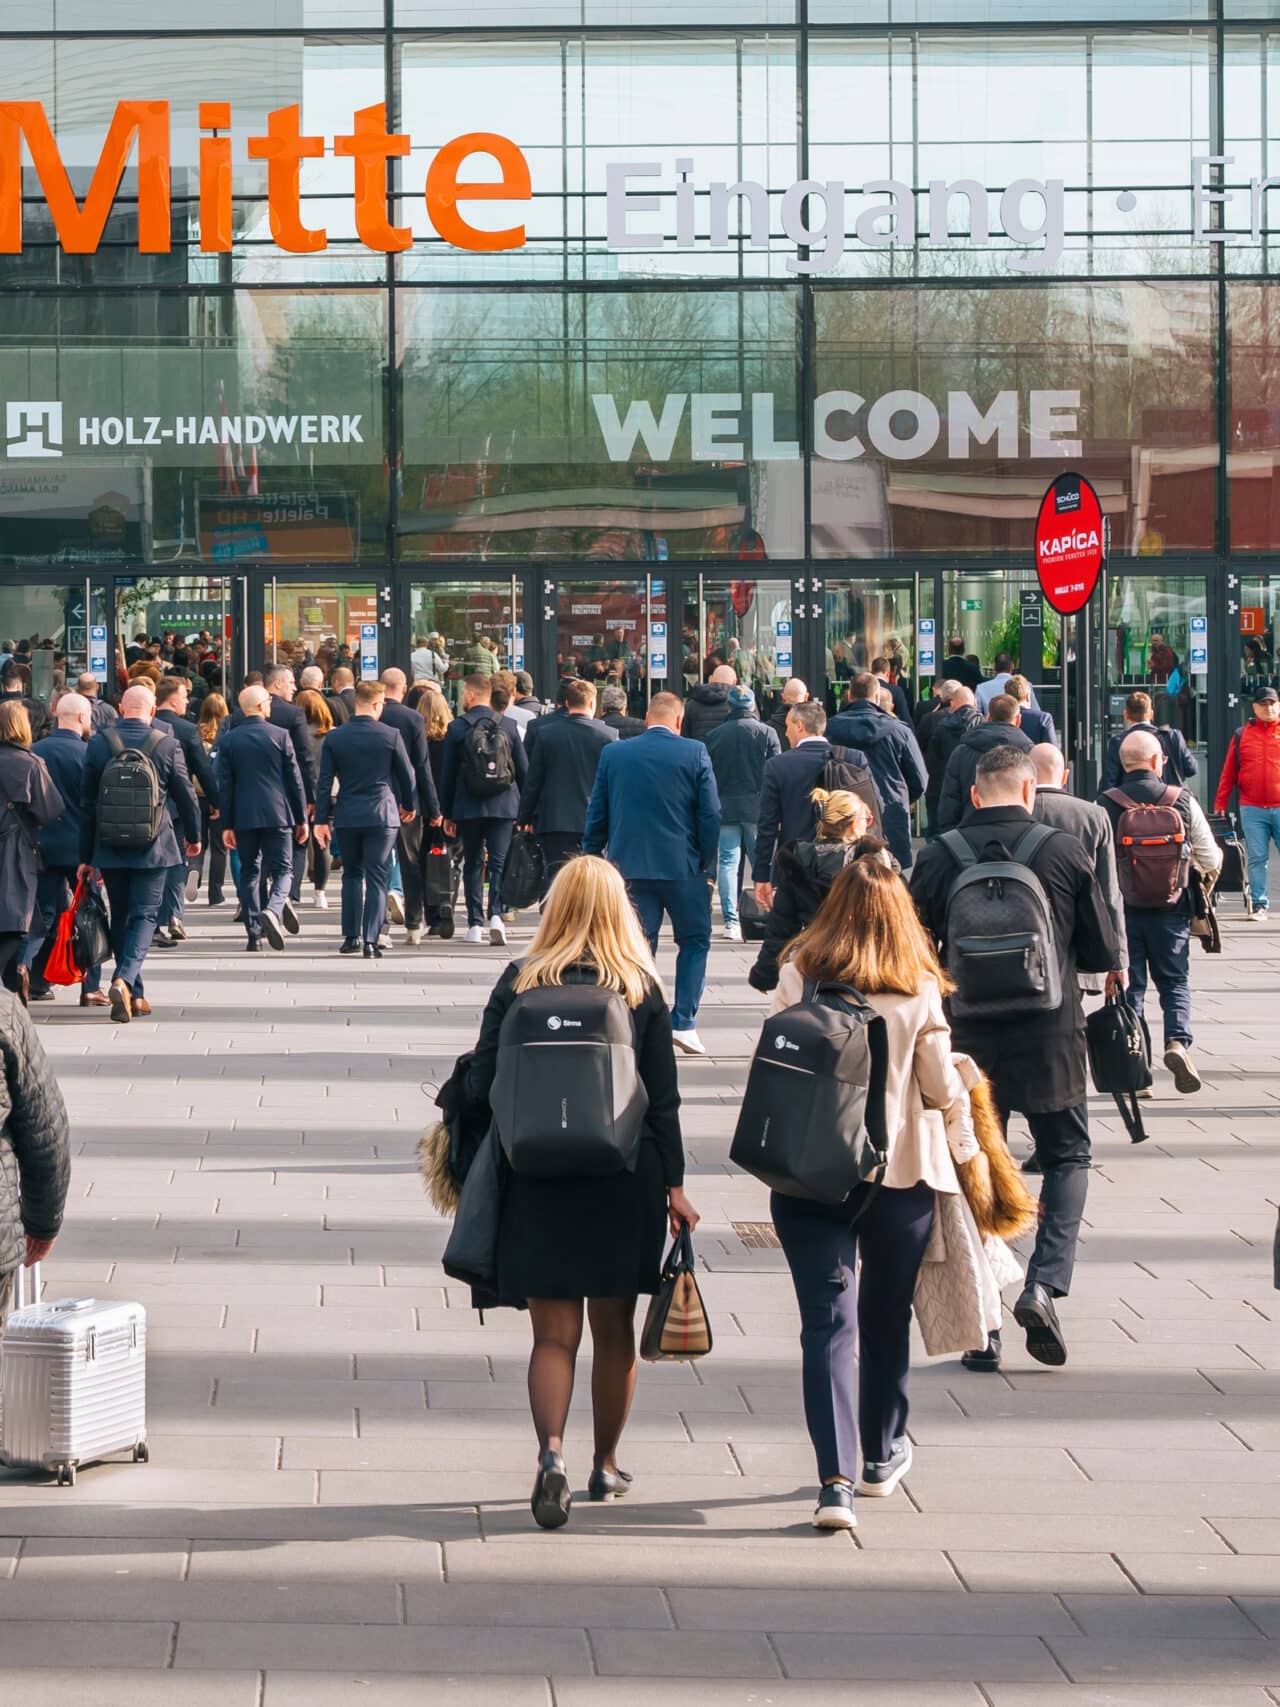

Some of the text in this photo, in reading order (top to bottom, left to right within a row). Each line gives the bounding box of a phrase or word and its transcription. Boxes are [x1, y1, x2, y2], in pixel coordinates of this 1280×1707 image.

[606, 157, 1064, 273] Eingang
[79, 414, 364, 446] HOLZ-HANDWERK
[592, 389, 1084, 462] WELCOME
